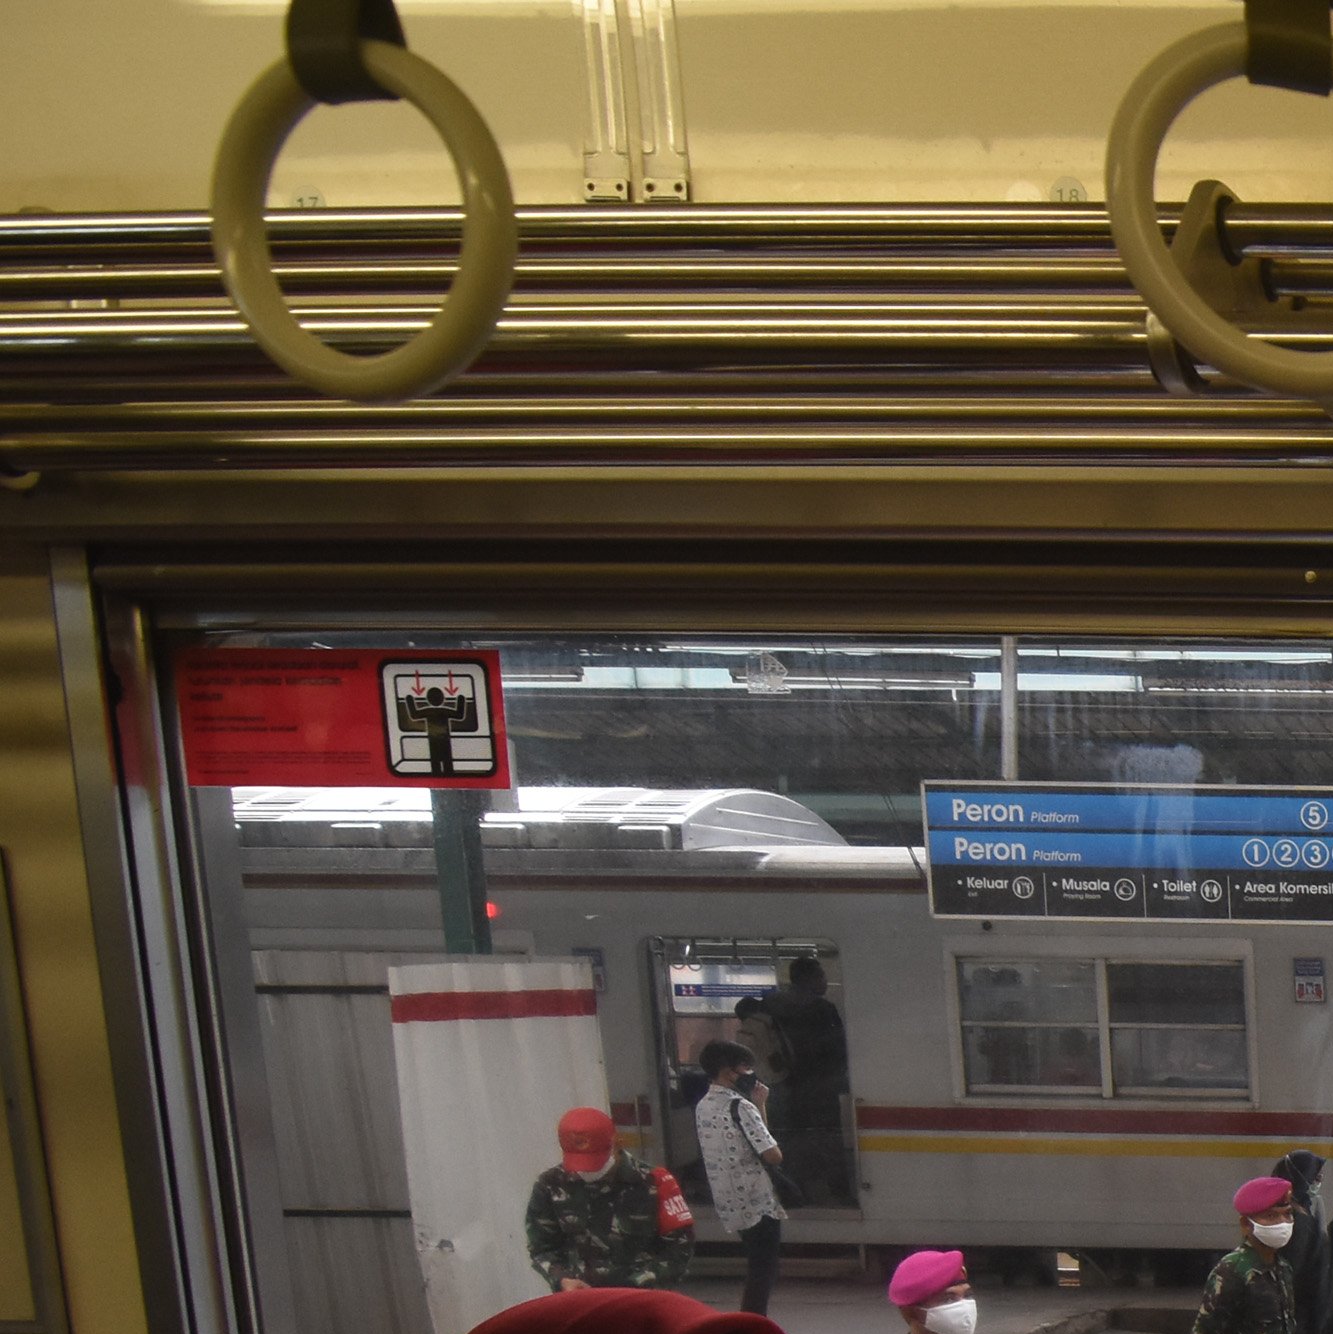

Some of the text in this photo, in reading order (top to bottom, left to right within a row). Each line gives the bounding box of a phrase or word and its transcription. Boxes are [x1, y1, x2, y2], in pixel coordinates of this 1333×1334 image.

[952, 798, 1024, 822] Peron
[1030, 811, 1080, 823] Platform
[954, 837, 1026, 861] Peron
[1033, 850, 1081, 862] Platform
[966, 876, 1009, 889] Keluar
[1062, 878, 1110, 891] Musala
[1162, 880, 1197, 892] Toilet
[1244, 881, 1276, 893] Area
